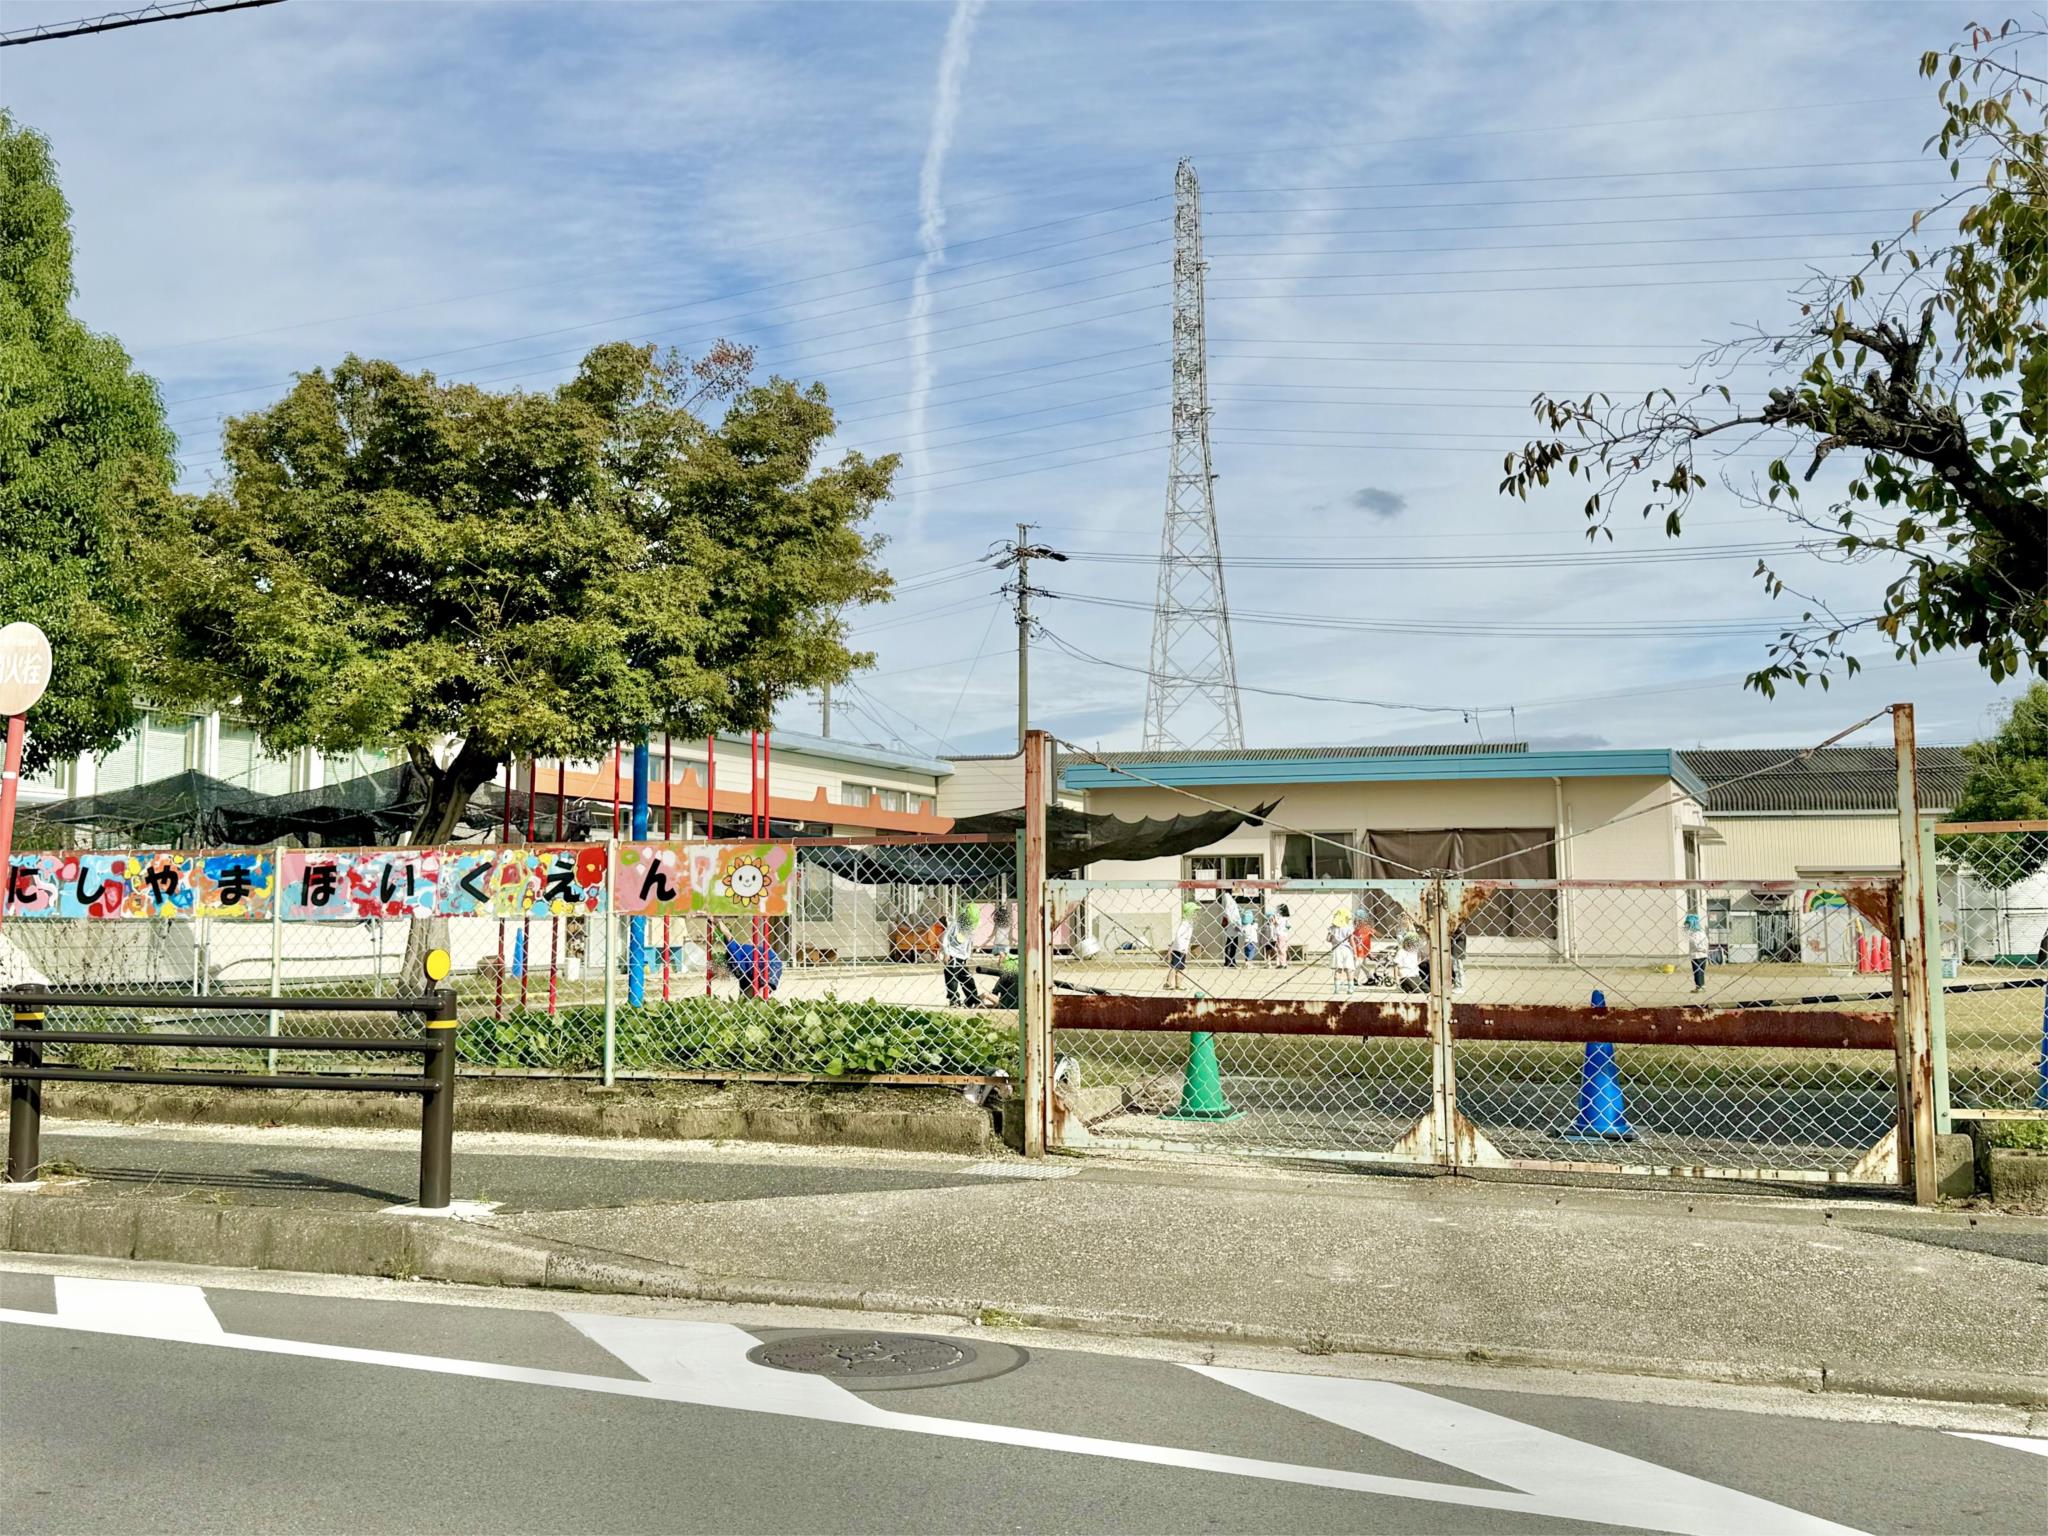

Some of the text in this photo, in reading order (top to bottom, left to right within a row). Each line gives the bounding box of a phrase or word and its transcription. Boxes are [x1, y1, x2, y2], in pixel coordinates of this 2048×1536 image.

[7, 858, 677, 906] にしやまほいくえん
